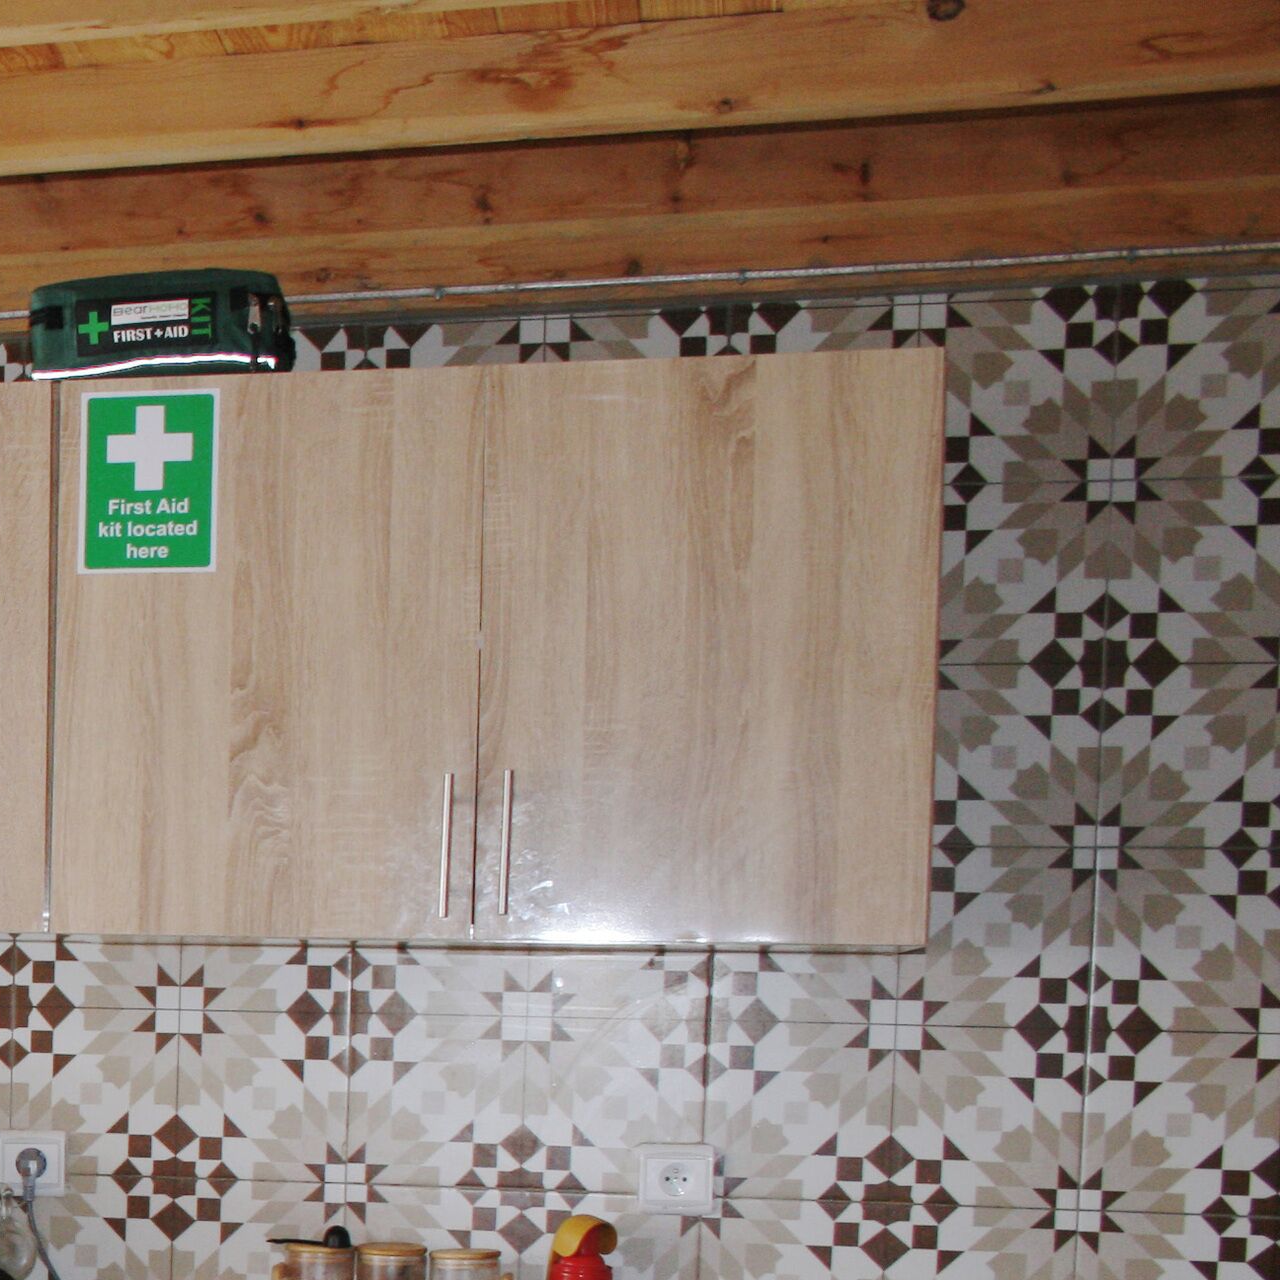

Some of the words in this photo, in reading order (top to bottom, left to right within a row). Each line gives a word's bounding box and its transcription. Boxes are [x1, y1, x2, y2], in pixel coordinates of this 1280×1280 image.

[192, 297, 212, 339] KIT
[108, 498, 152, 515] First
[155, 498, 189, 514] Aid
[98, 521, 122, 537] kit
[127, 519, 198, 536] located
[126, 542, 169, 559] here
